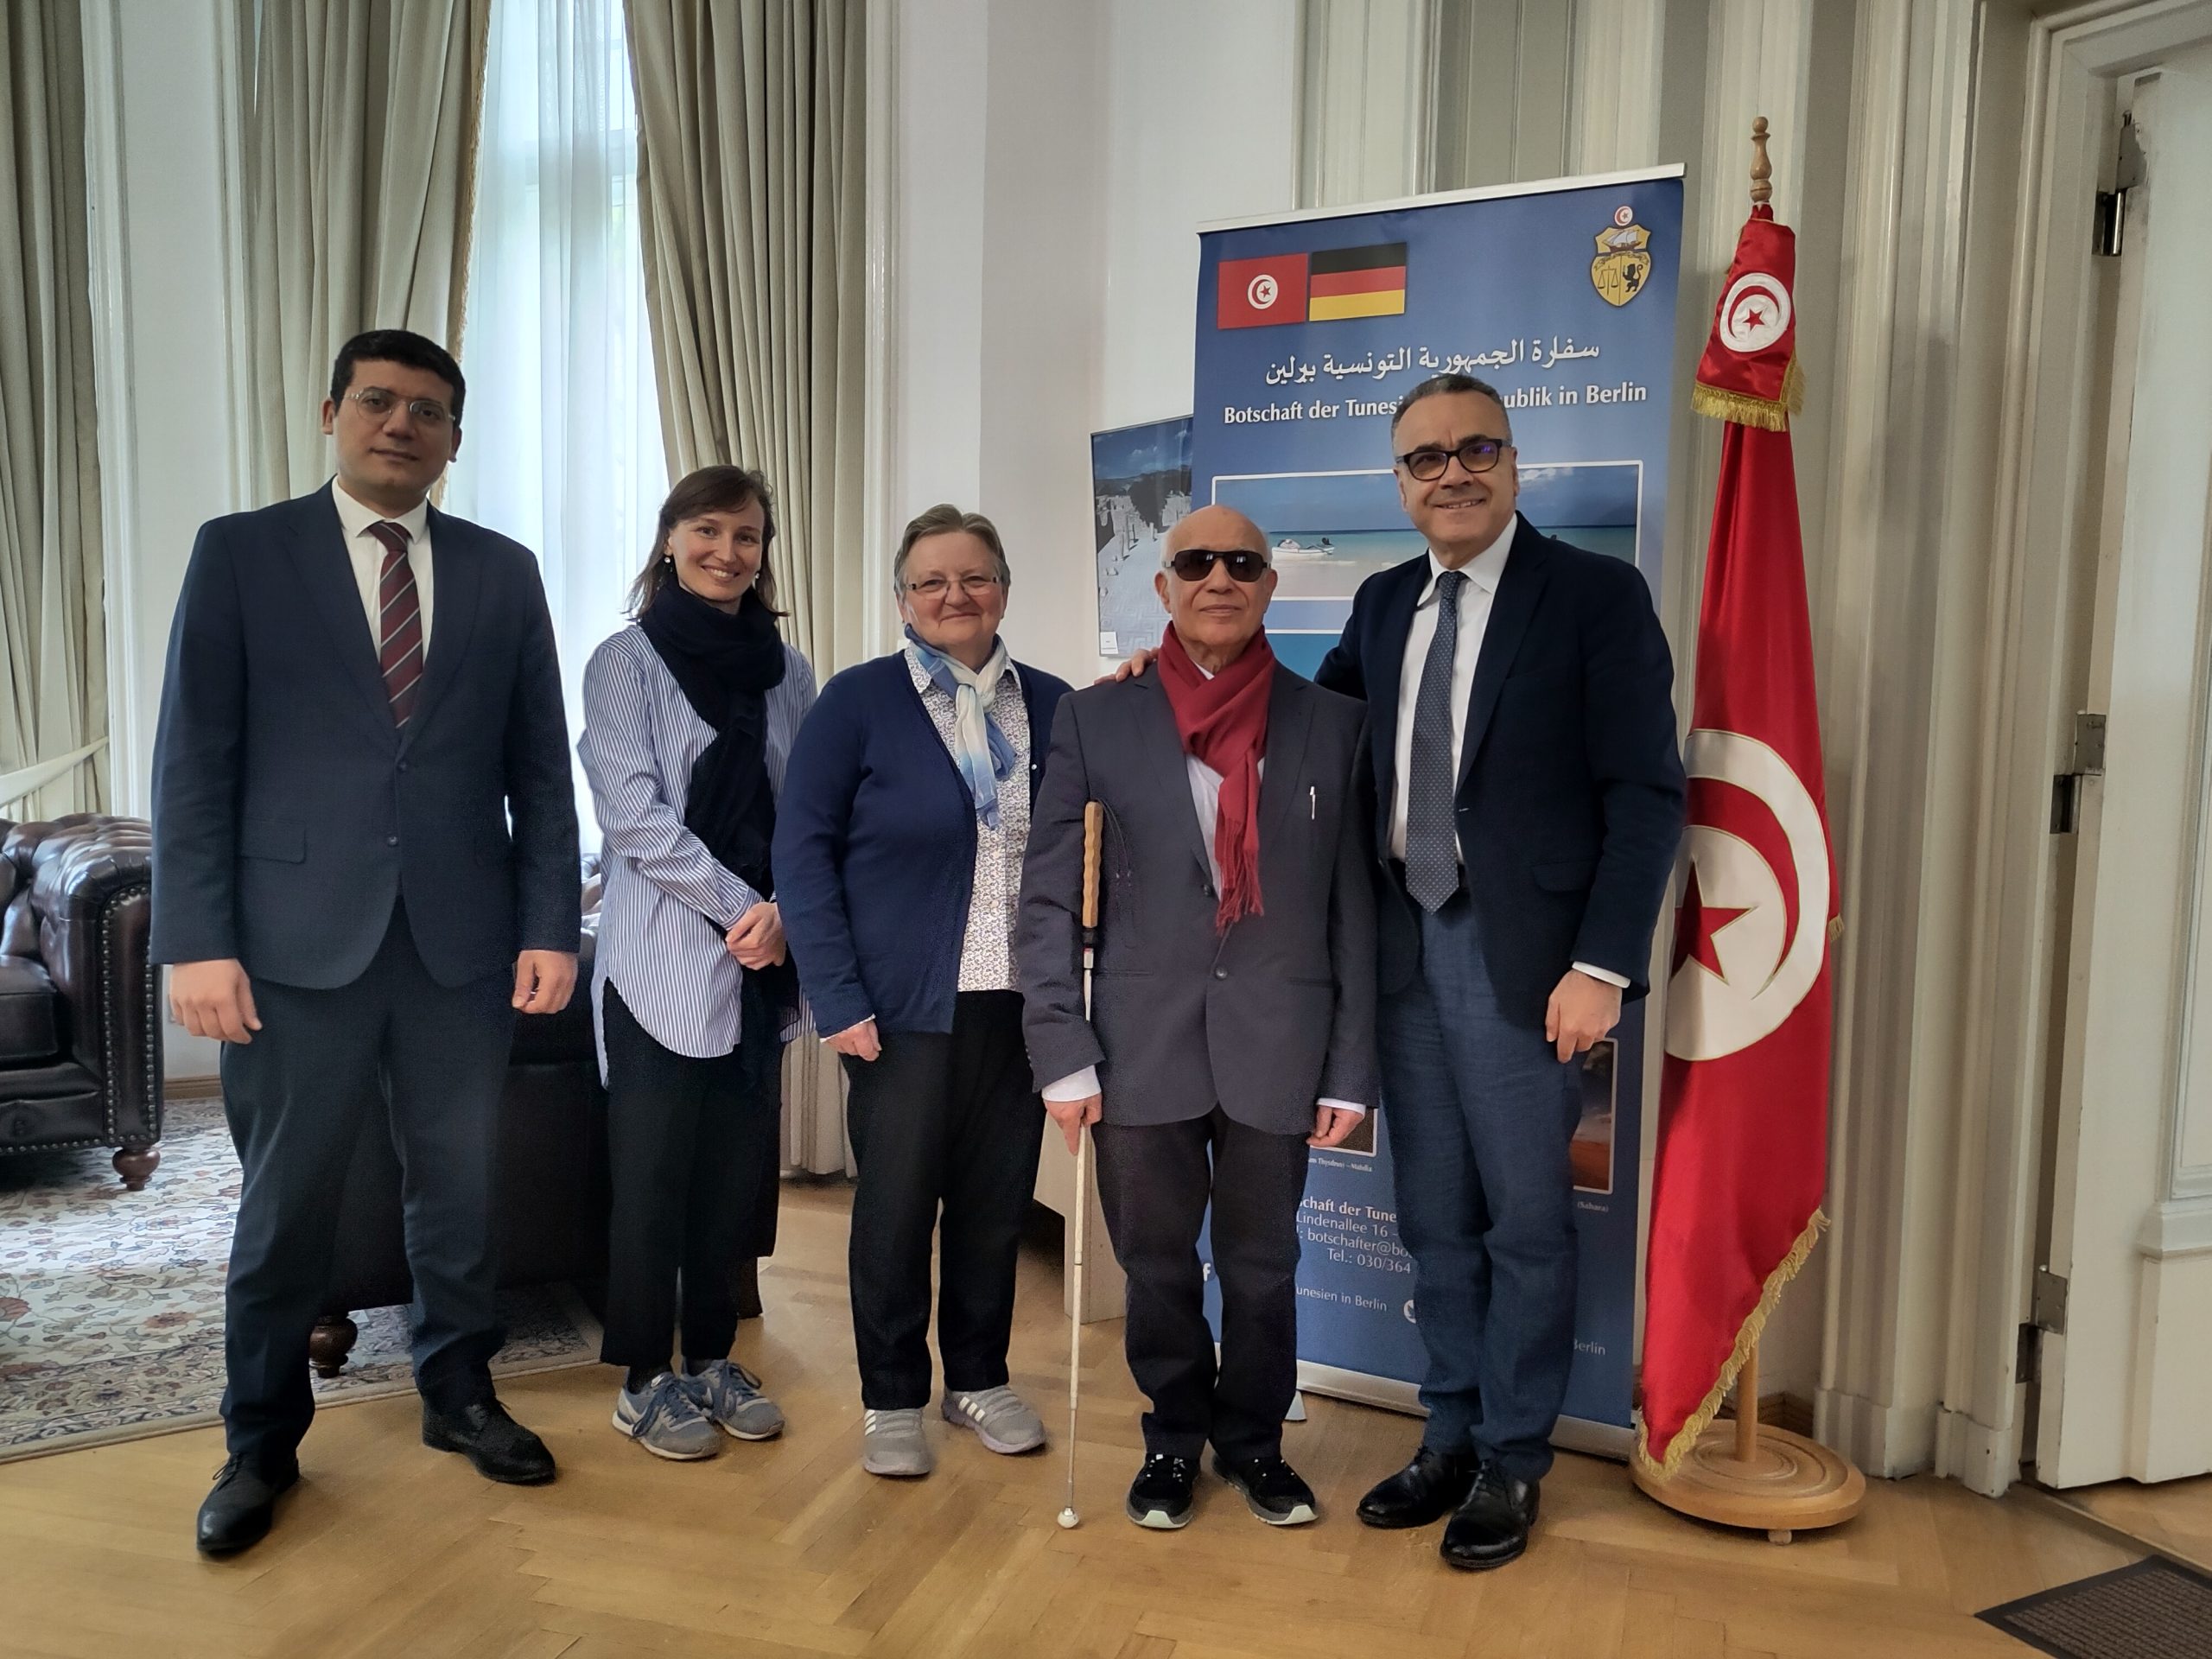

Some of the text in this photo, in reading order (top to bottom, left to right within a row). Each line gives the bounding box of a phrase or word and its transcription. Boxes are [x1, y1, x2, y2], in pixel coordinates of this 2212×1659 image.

[1323, 346, 1411, 380] التونسية
[1418, 338, 1524, 378] الجمهورية
[1531, 336, 1599, 368] سفارة
[1224, 401, 1303, 423] Botschaft
[1308, 400, 1339, 418] der
[1501, 386, 1552, 408] ublik
[1559, 385, 1578, 405] in
[1586, 382, 1647, 404] Berlin
[1296, 1211, 1368, 1233] Lindenallee
[1372, 1224, 1389, 1237] 16
[1338, 1202, 1362, 1217] der
[1365, 1206, 1397, 1223] Tune
[1307, 1228, 1413, 1259] botschafter@bo
[1327, 1248, 1411, 1274] Tel.: 030/364
[1296, 1287, 1388, 1312] unesien in Berlin
